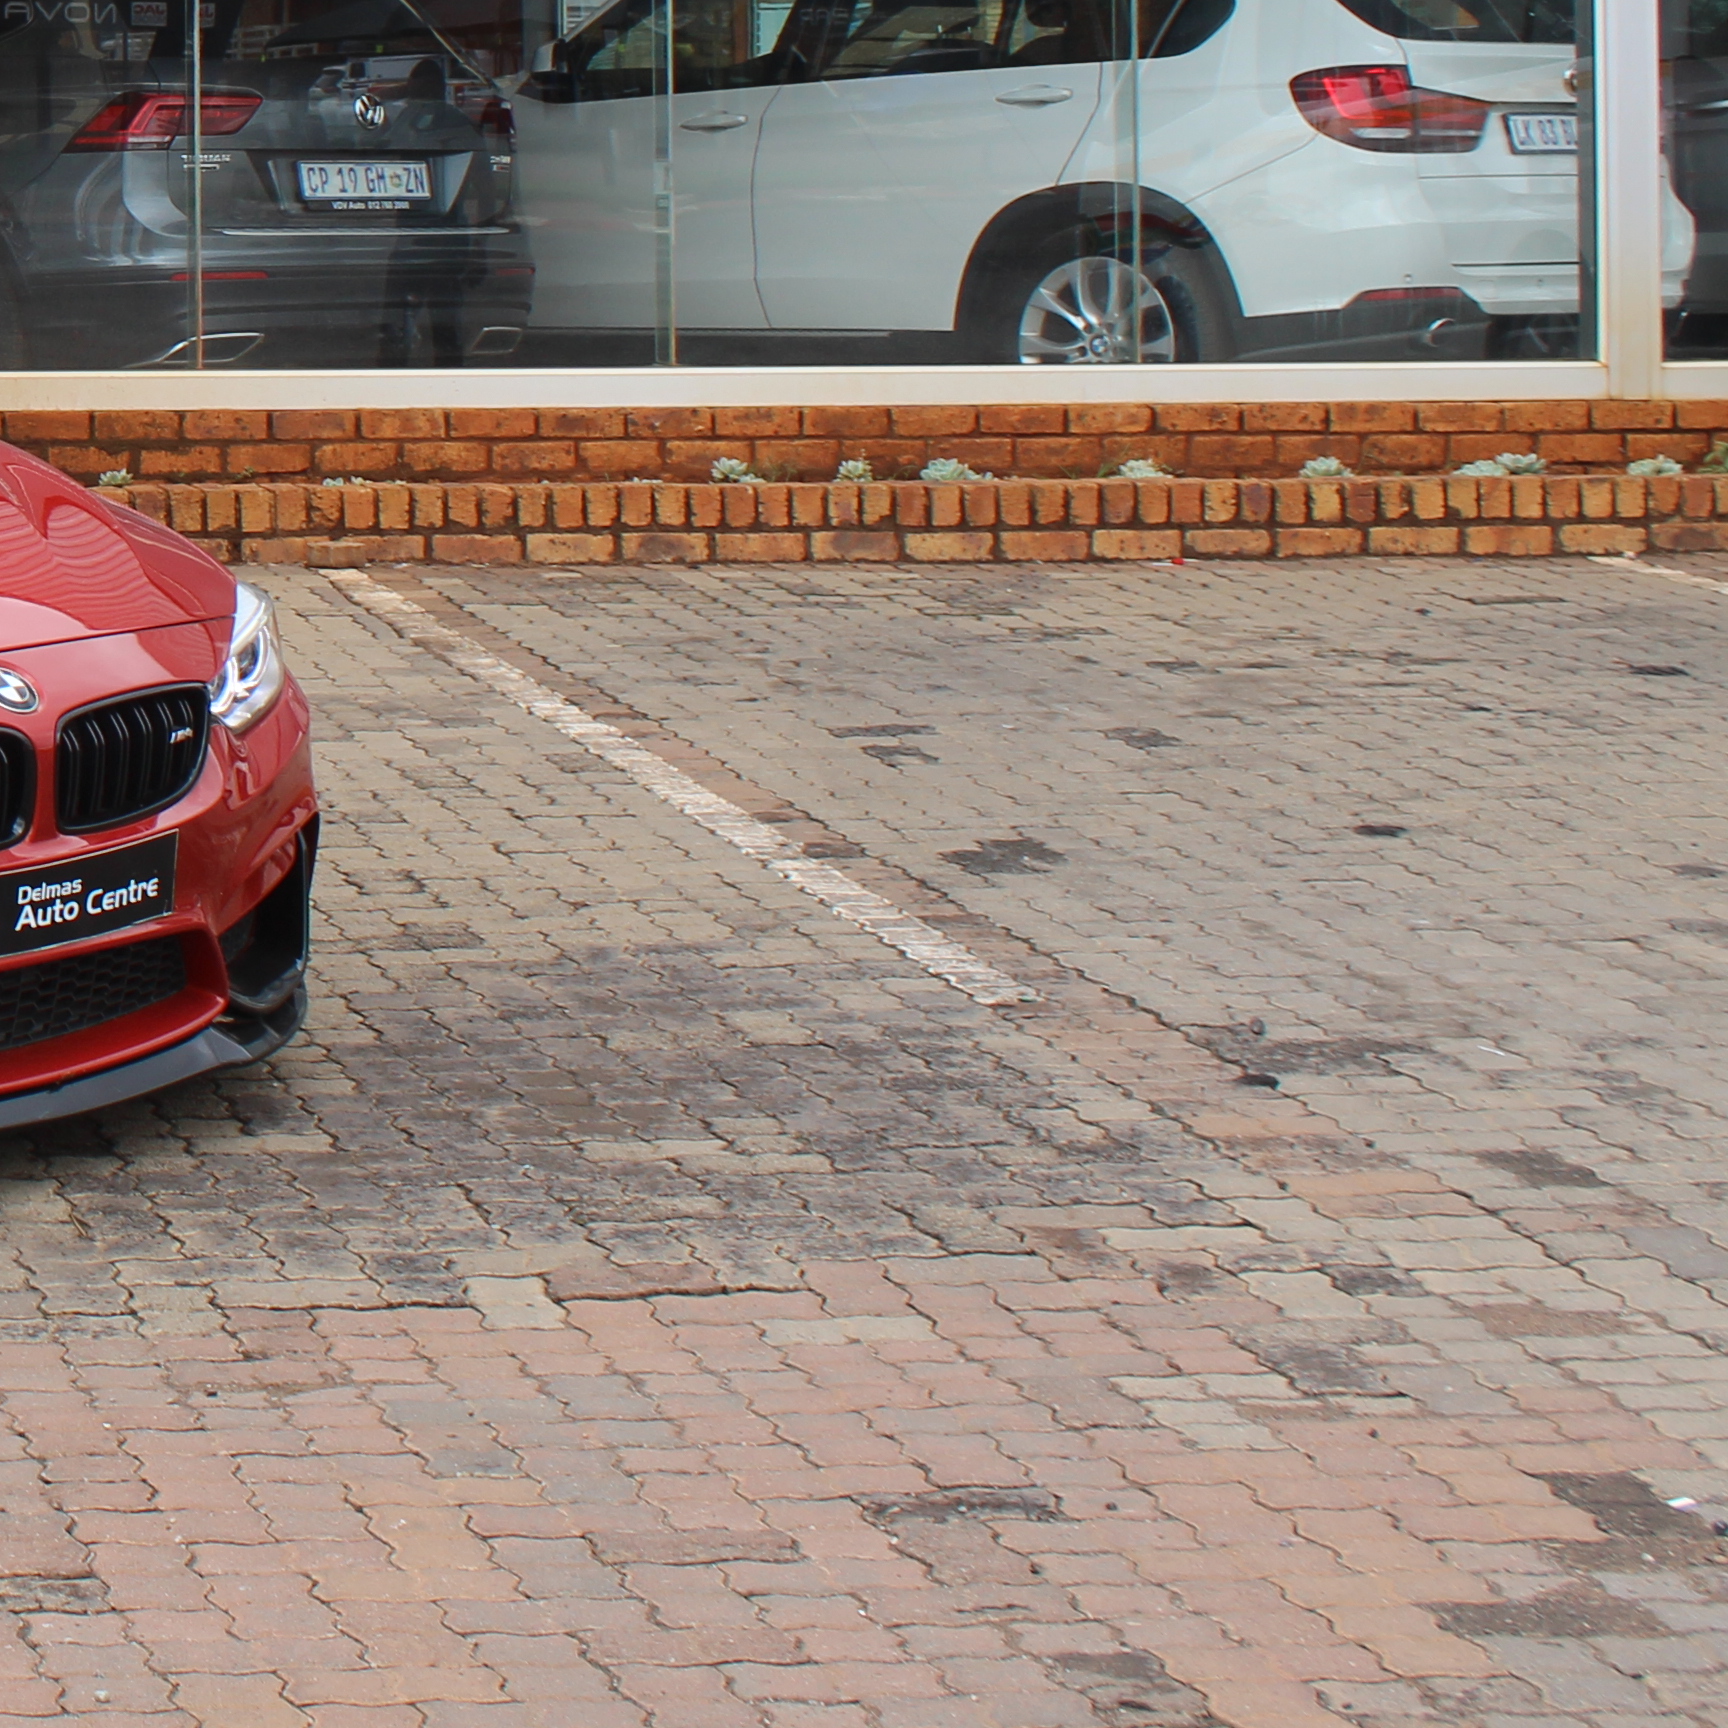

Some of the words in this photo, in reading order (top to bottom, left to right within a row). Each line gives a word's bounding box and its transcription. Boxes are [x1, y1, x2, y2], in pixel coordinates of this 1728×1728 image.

[306, 167, 329, 194] CP
[337, 167, 359, 194] 19
[403, 167, 426, 194] ZN
[15, 900, 79, 931] Auto
[86, 877, 159, 915] Centre
[17, 878, 82, 905] Delmas
